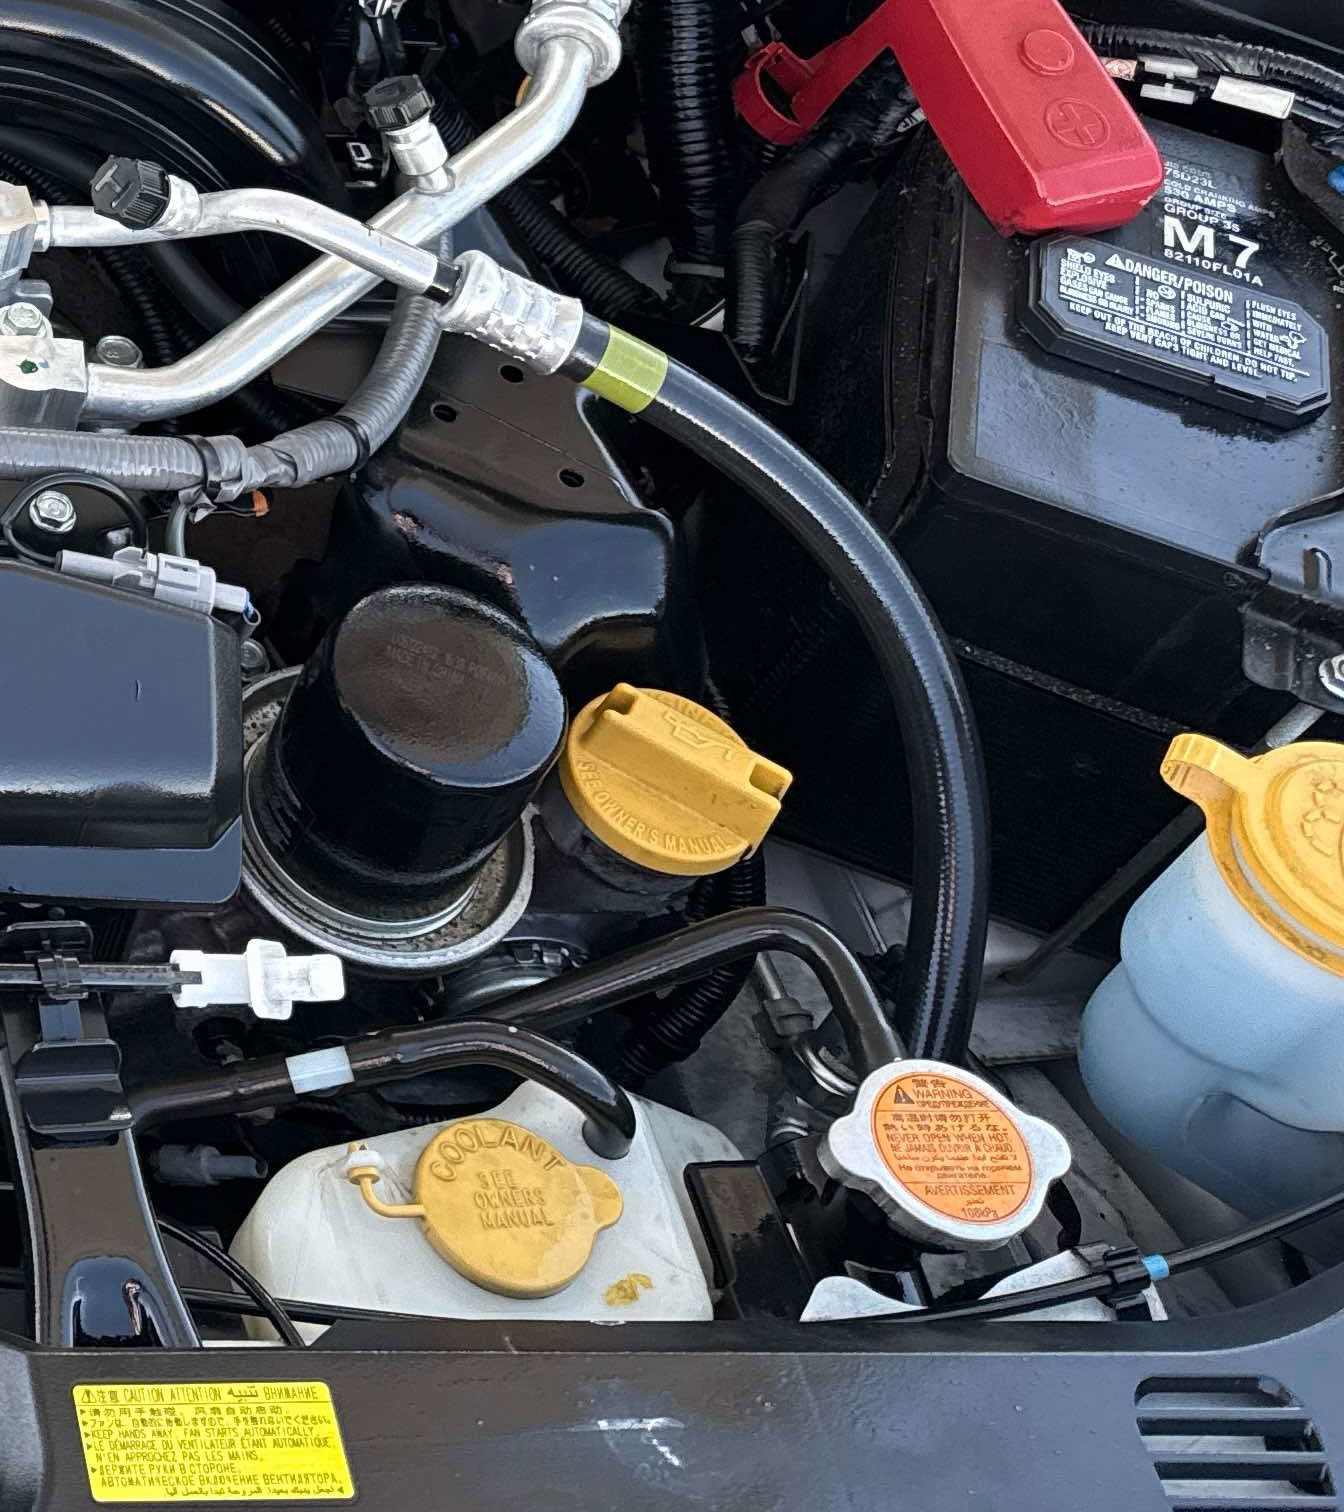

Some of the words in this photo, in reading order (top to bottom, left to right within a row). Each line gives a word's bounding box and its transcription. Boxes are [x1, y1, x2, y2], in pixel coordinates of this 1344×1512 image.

[1164, 167, 1217, 190] 75D23L
[1193, 194, 1237, 213] AMPS
[1164, 203, 1219, 225] GROUP
[1163, 215, 1216, 259] M
[1228, 233, 1260, 268] 7
[1164, 248, 1264, 287] 82110FL01A
[1124, 258, 1234, 304] DANGER/POISON
[1145, 287, 1160, 300] NO
[1069, 302, 1092, 316] KEEP
[1093, 309, 1114, 323] OUT
[1113, 317, 1127, 328] OF
[1128, 321, 1146, 334] THE
[1147, 327, 1178, 345] REACH
[1179, 337, 1193, 348] OF
[1244, 356, 1259, 369] DO
[1259, 362, 1280, 376] NOT
[1104, 322, 1129, 336] KEEP
[1129, 330, 1154, 345] VENT
[1154, 338, 1179, 353] CAPS
[1181, 345, 1209, 363] TIGHT
[1209, 355, 1230, 368] AND
[576, 759, 602, 789] SEE
[595, 790, 660, 846] OWNER'S
[664, 833, 732, 856] MANUAL
[913, 1088, 972, 1099] WARNING
[886, 1132, 921, 1143] NEVER
[924, 1132, 953, 1143] OPEN
[956, 1132, 985, 1143] WHEN
[430, 1125, 567, 1182] COOLANT
[891, 1143, 903, 1153] NE
[905, 1143, 937, 1153] JAMAIS
[939, 1143, 972, 1153] OUVRIR
[478, 1169, 518, 1189] SEE
[473, 1187, 546, 1210] OWNERS
[924, 1184, 1017, 1197] AVERTISSEMENT
[479, 1208, 555, 1231] MANUAL
[123, 1387, 164, 1403] CAUTION
[170, 1386, 222, 1403] ATTENTION
[263, 1386, 319, 1401] ВНИМАНИЕ
[92, 1429, 113, 1439] KEEP
[118, 1429, 146, 1439] HANDS
[183, 1428, 200, 1438] FAN
[206, 1427, 238, 1438] STARTS
[94, 1440, 105, 1451] LE
[109, 1439, 156, 1451] DÉMARRAGE
[162, 1440, 174, 1450] DU
[177, 1438, 235, 1450] VENTILATEUR
[240, 1436, 266, 1449] ÉTANT
[96, 1451, 120, 1462] N'EN
[126, 1450, 177, 1462] APPROCHEZ
[182, 1450, 201, 1462] PAS
[206, 1450, 224, 1461] LES
[99, 1464, 144, 1476] ДЕРЖИТЕ
[148, 1463, 176, 1475] РУКИ
[179, 1463, 187, 1475] В
[101, 1474, 193, 1487] АВТОМАТИЧЕСКОЕ
[199, 1473, 259, 1486] ВКЛЮЧЕНИЕ
